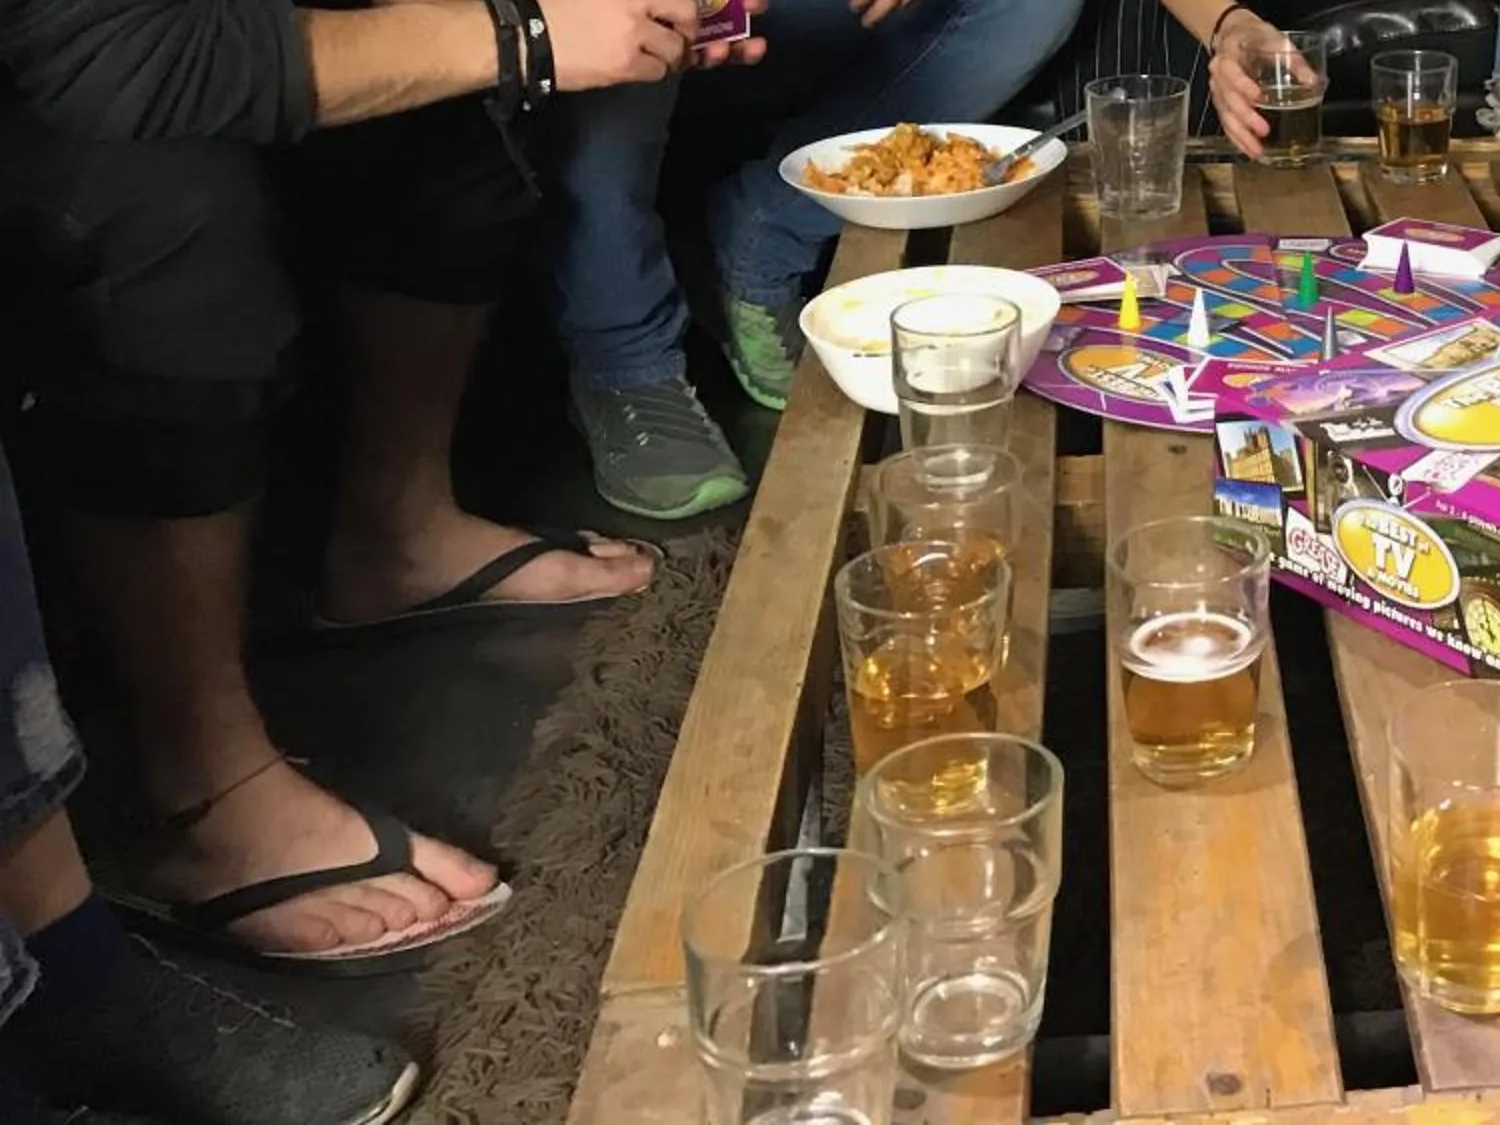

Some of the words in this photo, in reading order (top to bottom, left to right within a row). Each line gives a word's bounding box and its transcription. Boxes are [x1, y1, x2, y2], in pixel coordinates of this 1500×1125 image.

[1378, 515, 1418, 548] BEST
[1371, 532, 1417, 579] TV
[1279, 555, 1309, 578] game
[1312, 572, 1324, 586] of
[1327, 579, 1371, 610] moving
[1373, 598, 1423, 633] pictures
[1425, 625, 1444, 642] we
[1447, 632, 1483, 660] know
